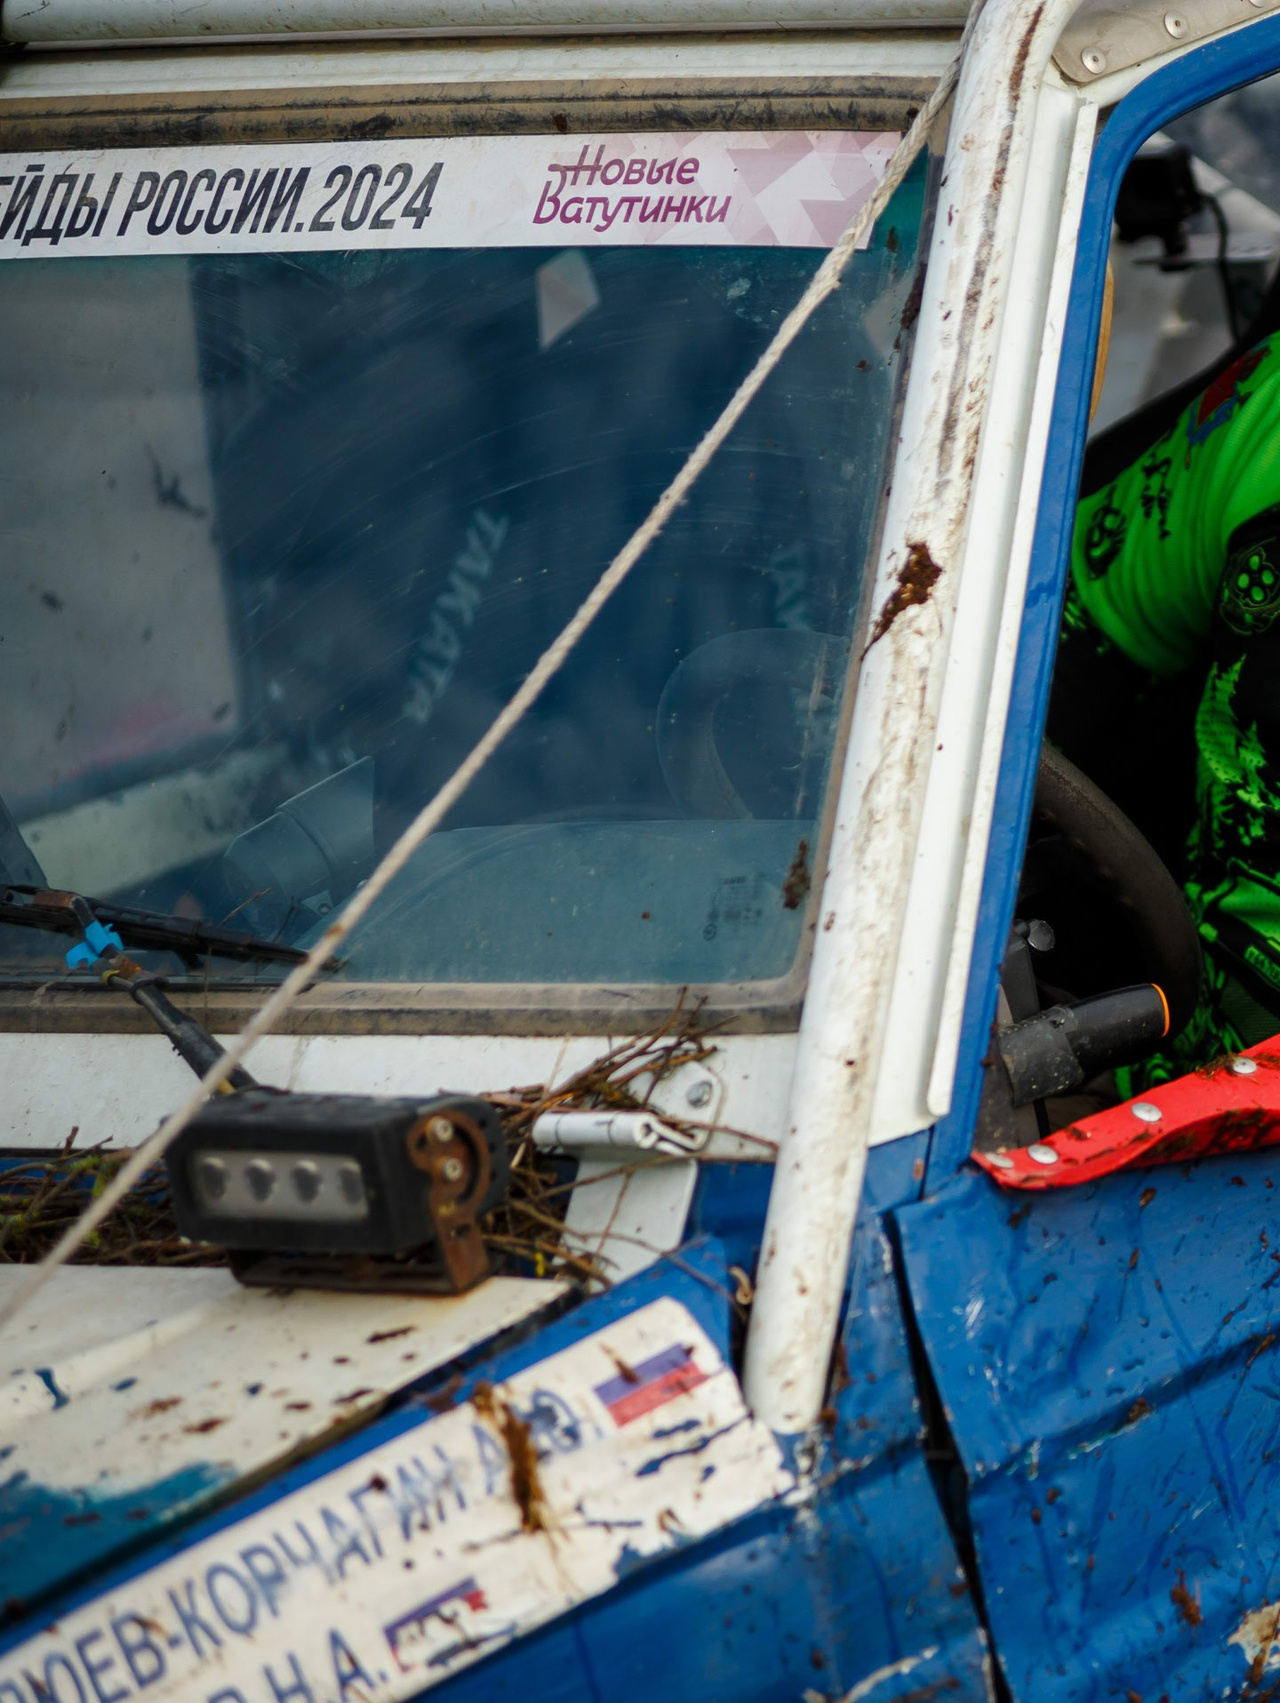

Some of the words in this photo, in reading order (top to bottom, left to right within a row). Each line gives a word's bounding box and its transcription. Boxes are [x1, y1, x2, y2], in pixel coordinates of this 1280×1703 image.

[548, 144, 701, 187] Новые
[0, 163, 123, 247] ЙДЫ
[117, 161, 445, 237] РОССИИ.2024
[532, 170, 732, 233] Ватутинки
